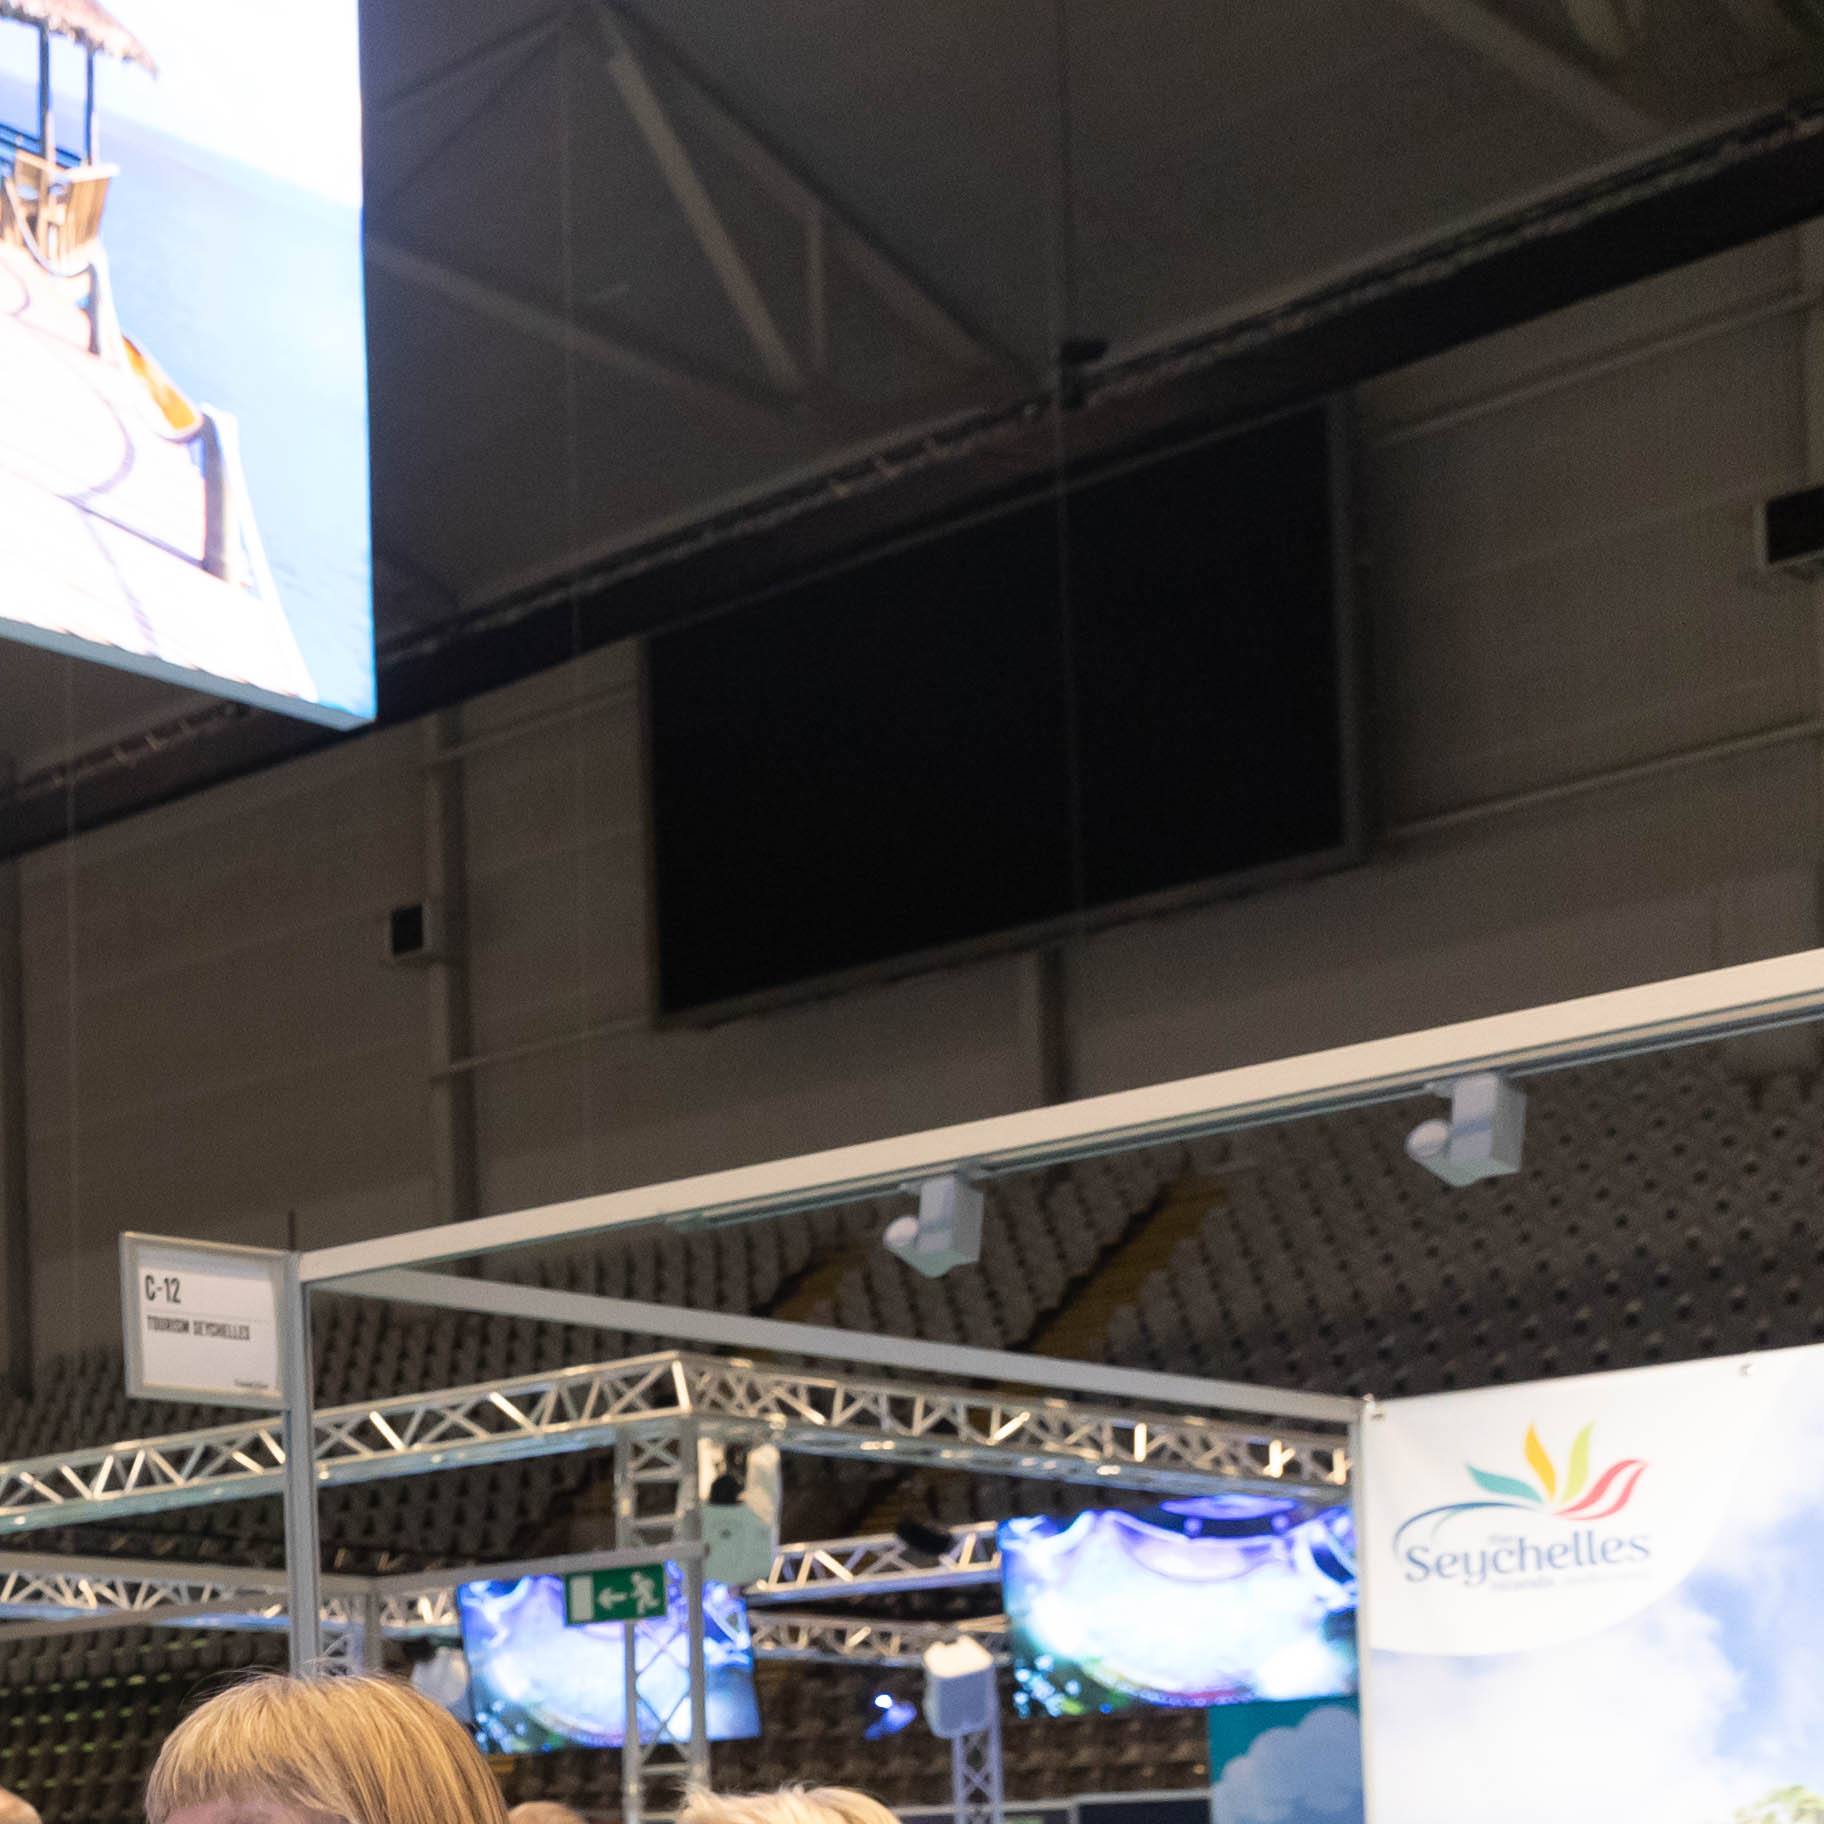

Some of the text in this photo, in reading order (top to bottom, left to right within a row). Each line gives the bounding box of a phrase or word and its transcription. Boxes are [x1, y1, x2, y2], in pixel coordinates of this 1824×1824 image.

[145, 1274, 181, 1304] C-12
[193, 1320, 250, 1340] SEYCHELLES
[1405, 1529, 1651, 1588] Seychelles
